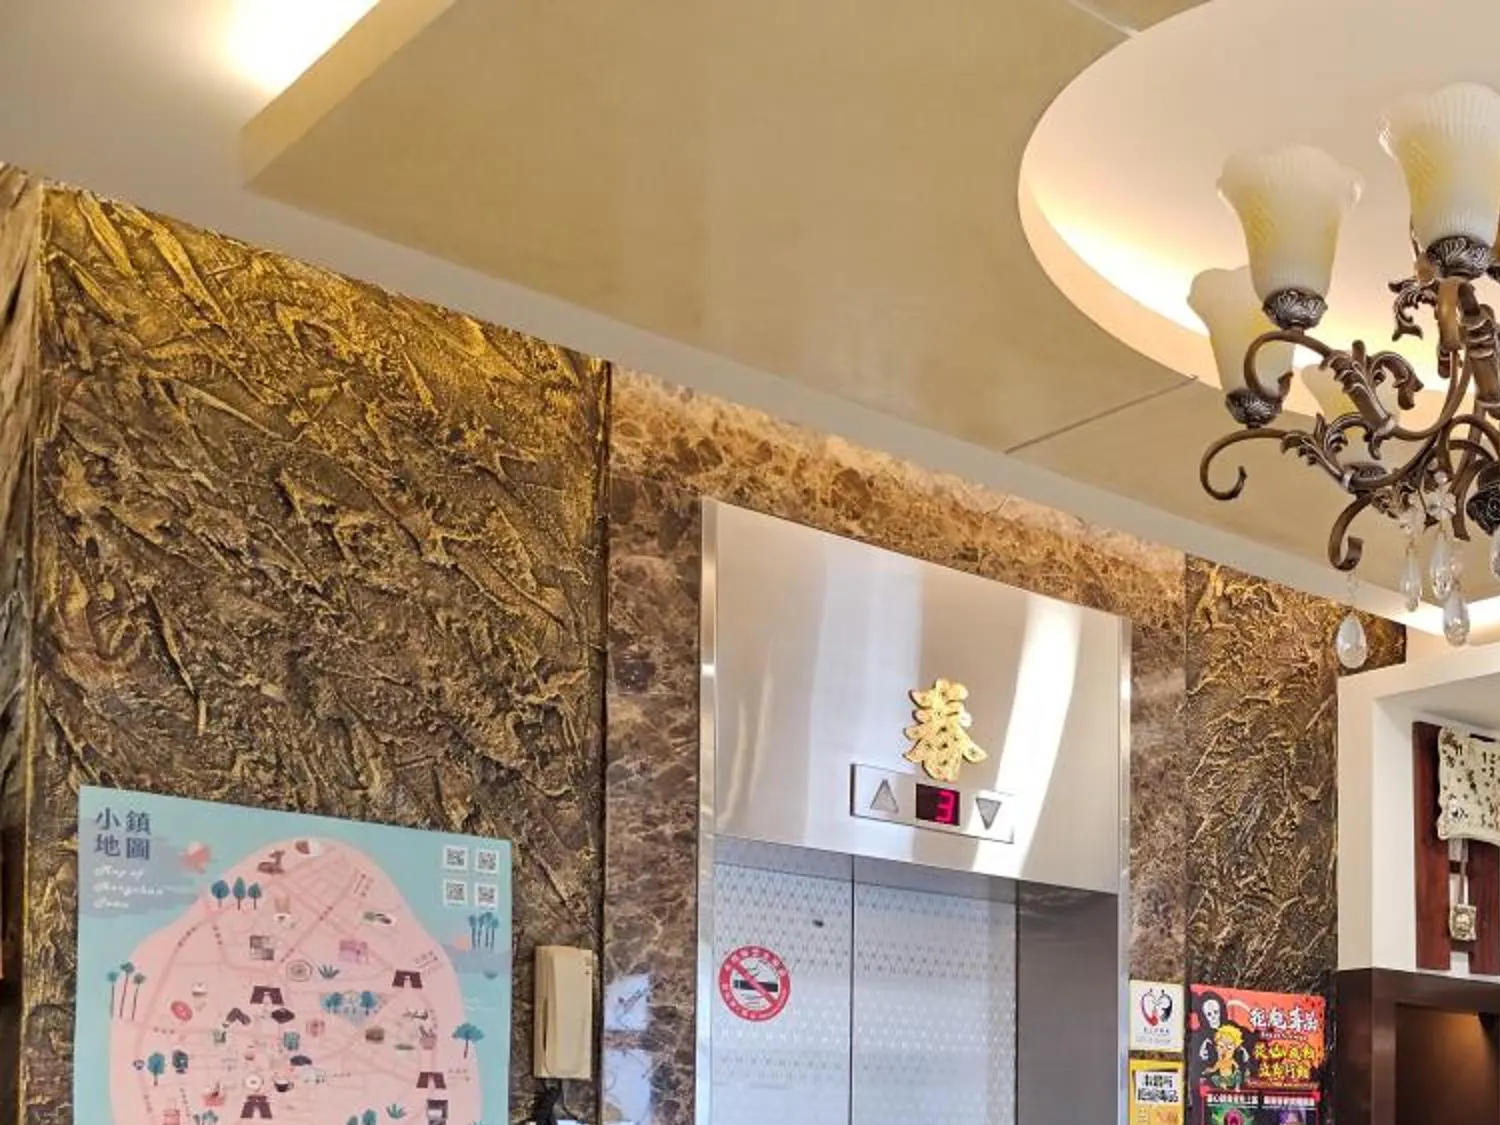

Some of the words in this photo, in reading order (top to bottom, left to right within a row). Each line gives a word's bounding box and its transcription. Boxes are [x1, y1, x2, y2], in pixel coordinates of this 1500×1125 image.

[934, 788, 955, 825] 3
[96, 807, 151, 835] 小鎮
[95, 833, 150, 860] 地圖
